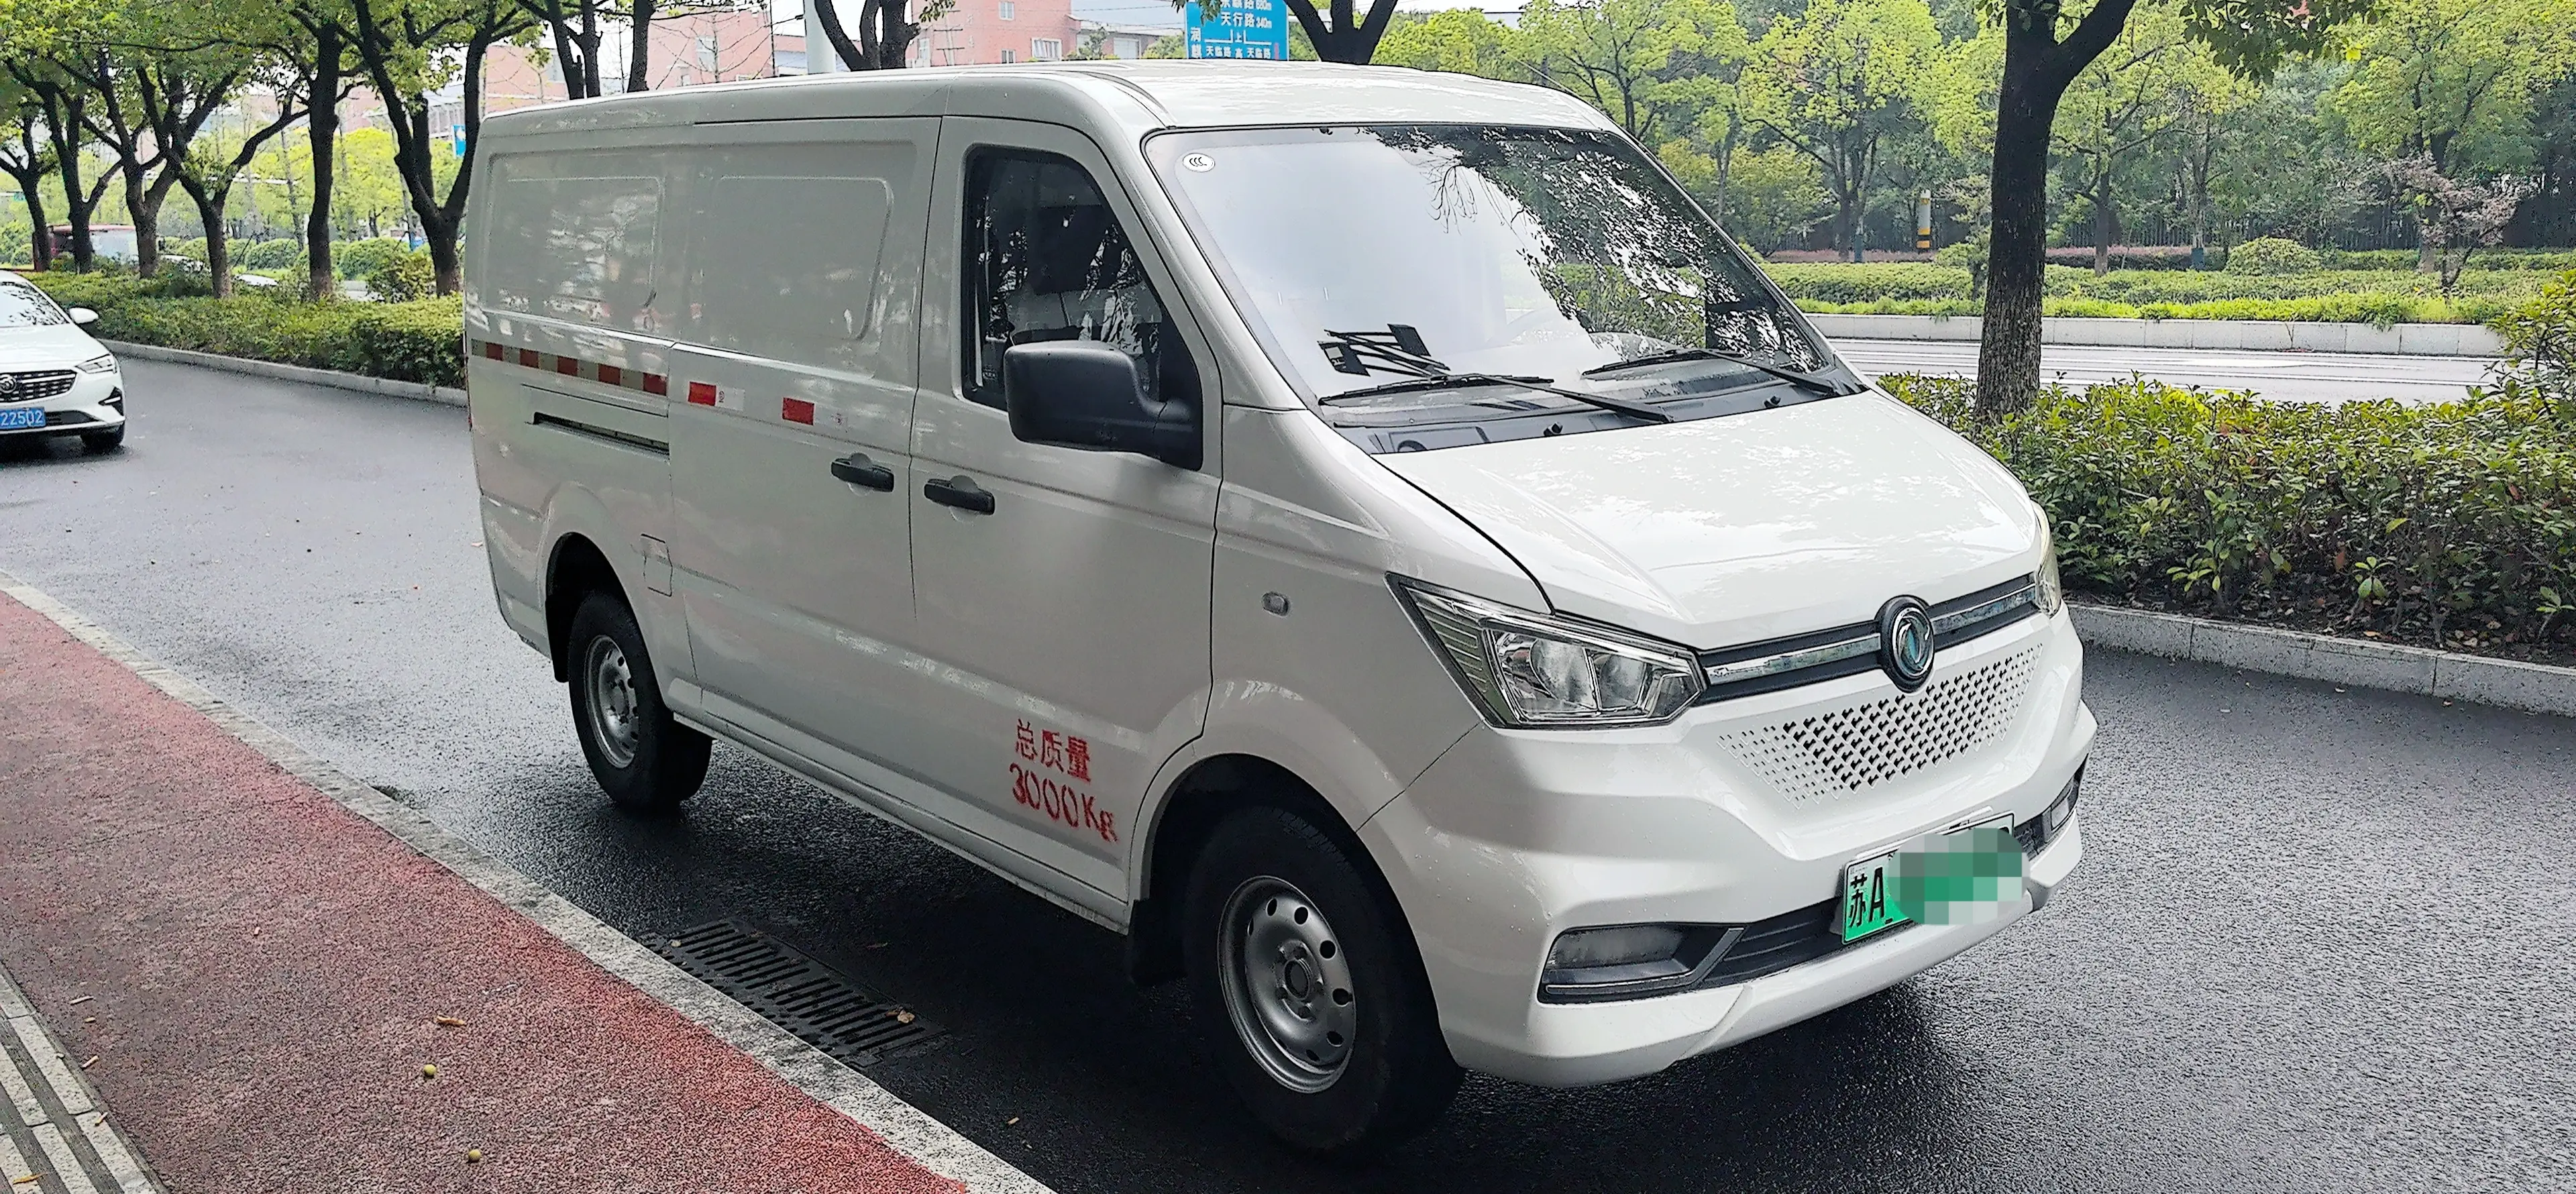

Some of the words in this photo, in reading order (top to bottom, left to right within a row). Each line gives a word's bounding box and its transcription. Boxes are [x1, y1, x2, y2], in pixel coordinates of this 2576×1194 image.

[1221, 12, 1254, 28] 天行路
[1256, 17, 1272, 29] 340m
[1015, 718, 1091, 782] 总质量
